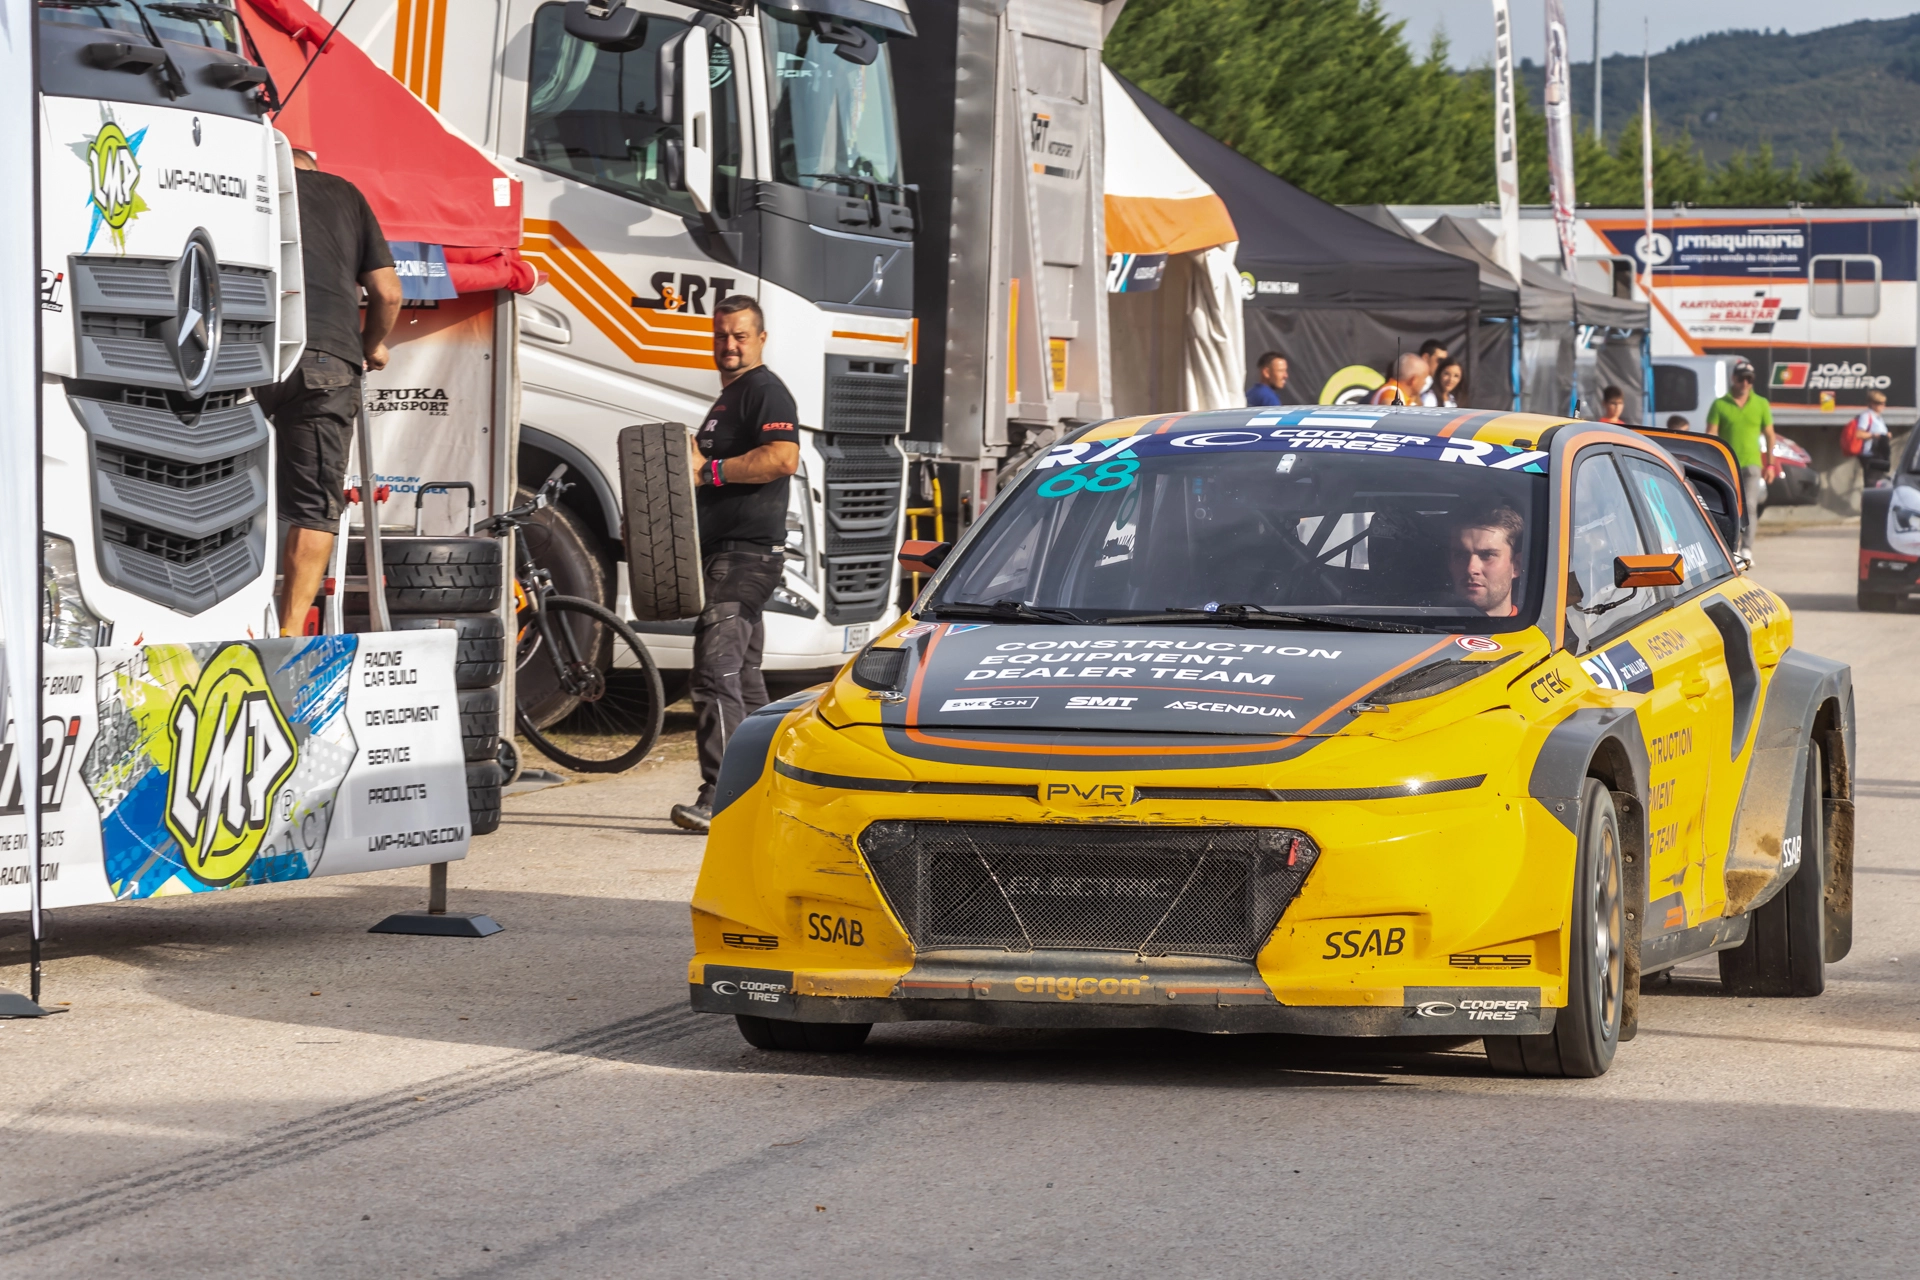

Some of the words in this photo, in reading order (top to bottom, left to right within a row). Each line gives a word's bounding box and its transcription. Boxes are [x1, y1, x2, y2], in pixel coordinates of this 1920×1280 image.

[158, 168, 247, 200] LMP-RACING.COM
[1680, 254, 1711, 263] compra
[1257, 280, 1281, 293] RACING
[1281, 281, 1299, 294] TEAM
[1726, 310, 1775, 320] BALTAR
[1812, 361, 1867, 375] JOÃO
[1809, 376, 1891, 389] RIBEIRO
[376, 388, 449, 400] FUKA
[366, 401, 449, 412] RANSPORT
[1269, 429, 1431, 448] COOPER
[1287, 438, 1402, 453] TIRES
[1036, 434, 1152, 469] RX
[1438, 437, 1549, 473] RX
[1037, 459, 1141, 498] 68
[1732, 588, 1779, 629] engcon
[995, 639, 1342, 659] CONSTRUCTION
[1646, 627, 1691, 661] ASCENDUM
[364, 651, 402, 668] RACING
[978, 652, 1244, 666] EQUIPMENT
[50, 675, 83, 695] BRAND
[364, 671, 385, 687] CAR
[388, 669, 417, 686] BUILD
[963, 666, 1136, 681] DEALER
[1151, 667, 1276, 685] TEAM
[1530, 668, 1571, 704] CTEK
[951, 699, 1028, 709] SWECON
[1068, 696, 1138, 708] SMT
[1164, 700, 1296, 719] ASCENDUM
[365, 705, 440, 726] DEVELOPMENT
[367, 746, 411, 765] SERVICE
[171, 692, 294, 860] LMP
[368, 783, 427, 805] PRODUCTS
[368, 826, 465, 852] LMP-RACING.COM
[1656, 822, 1679, 856] TEAM
[1783, 835, 1801, 867] SSAB
[808, 913, 864, 947] SSAB
[1322, 927, 1406, 960] SSAB
[740, 981, 787, 991] COOPER
[1014, 975, 1141, 1001] engcon
[748, 992, 779, 1003] TIRES
[1459, 1000, 1529, 1010] COOPER
[1468, 1011, 1517, 1021] TIRES
